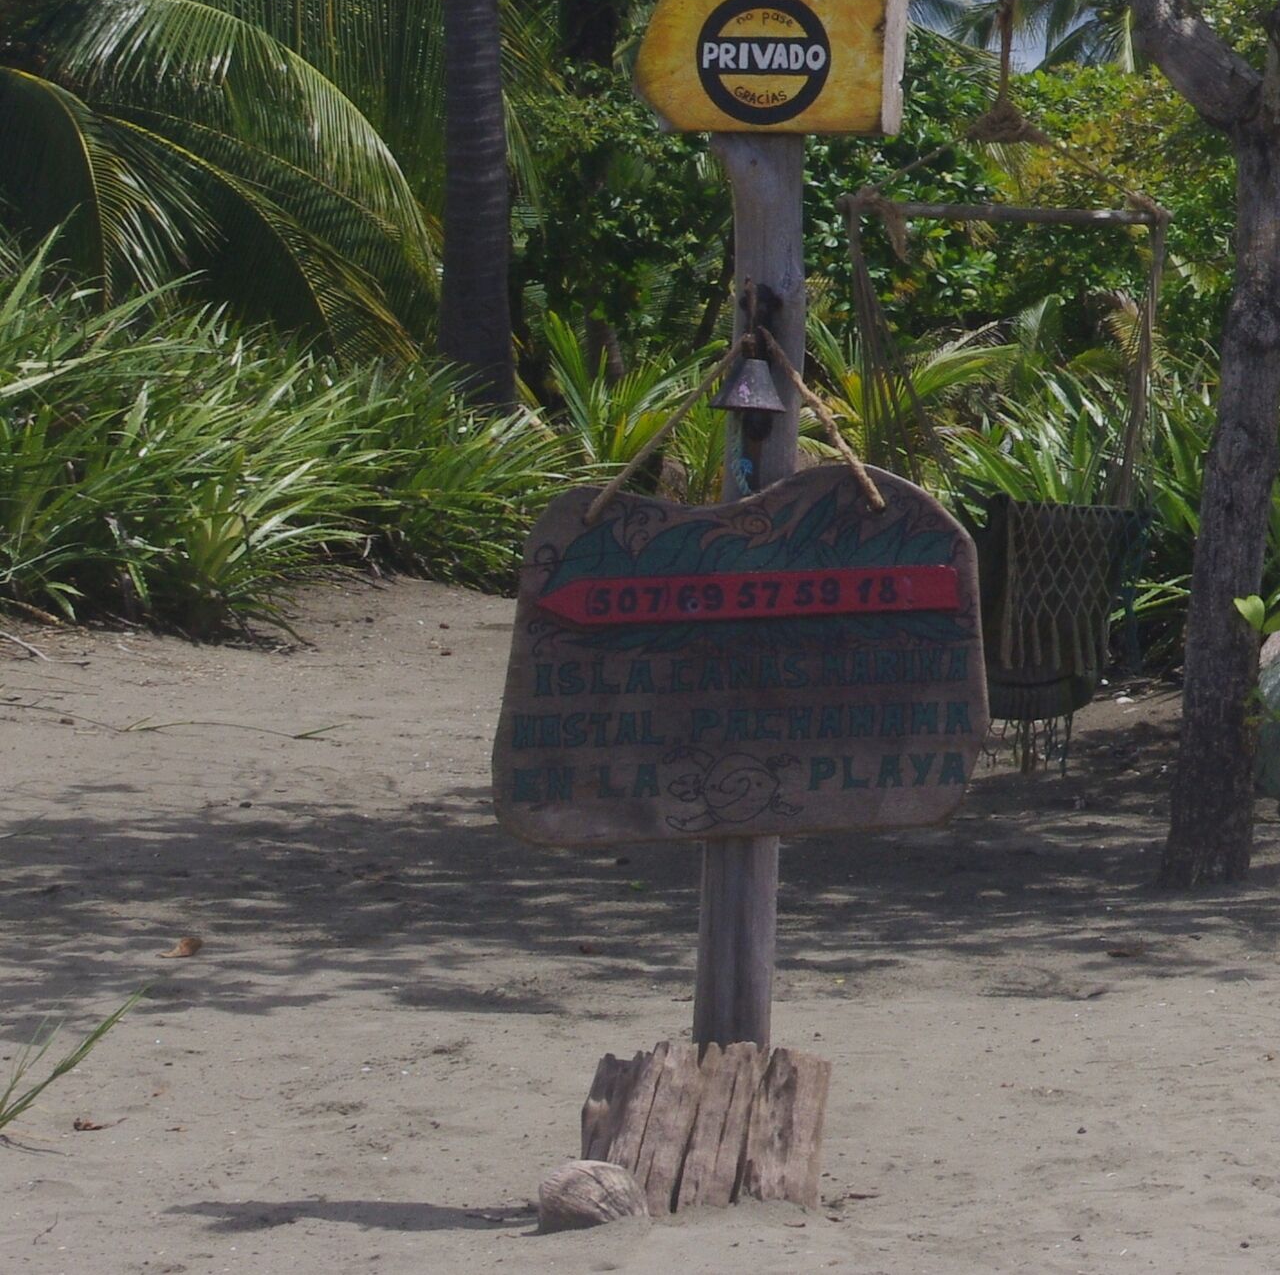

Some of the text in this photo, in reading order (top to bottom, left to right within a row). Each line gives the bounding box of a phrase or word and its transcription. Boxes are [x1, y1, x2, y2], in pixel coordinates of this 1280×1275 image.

[762, 11, 794, 29] pase
[702, 42, 826, 71] PRIVADO
[736, 579, 783, 610] 57
[793, 577, 839, 607] 59
[689, 700, 973, 743] PACHAMAMA
[598, 762, 660, 800] LA
[808, 751, 968, 792] PLAYA
